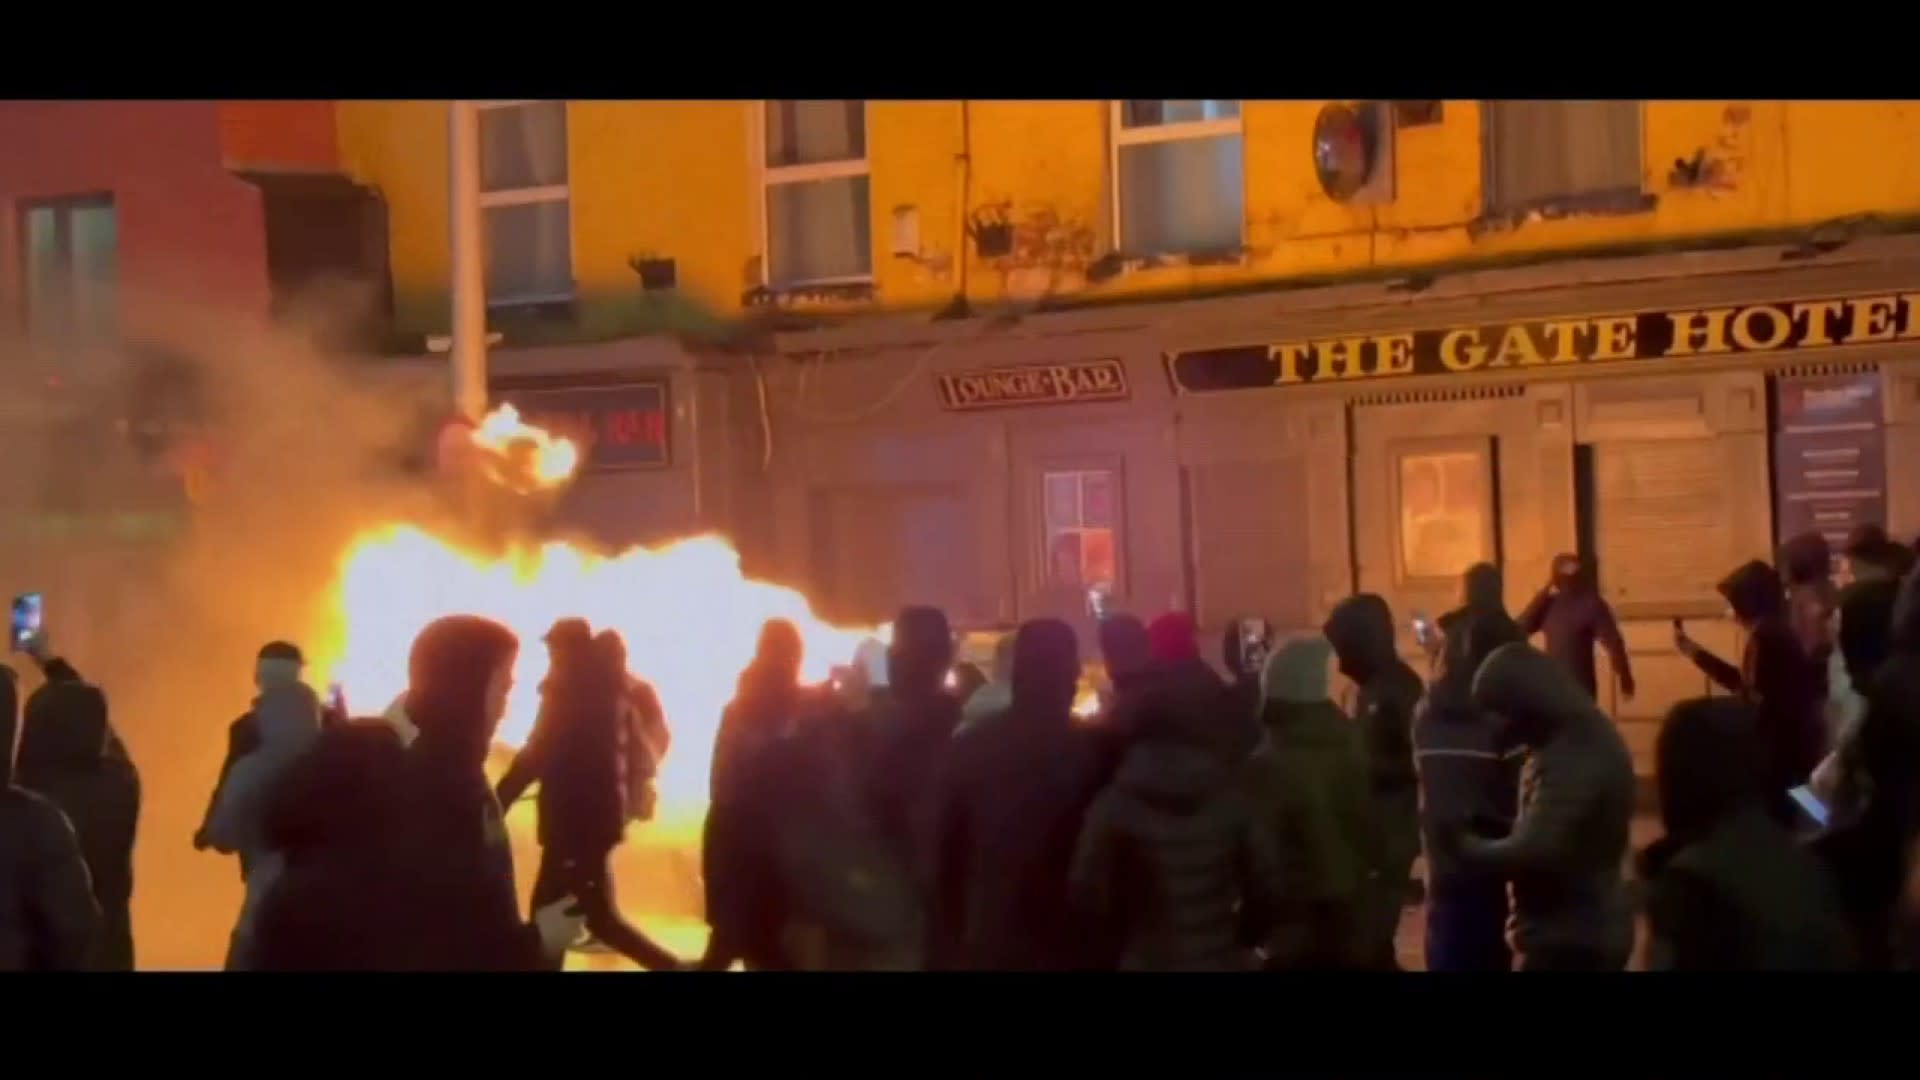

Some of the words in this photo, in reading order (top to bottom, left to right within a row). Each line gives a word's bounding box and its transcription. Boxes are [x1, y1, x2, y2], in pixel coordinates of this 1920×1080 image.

[1269, 335, 1415, 383] THE
[1439, 316, 1638, 372] GATE
[1048, 365, 1119, 400] BAR
